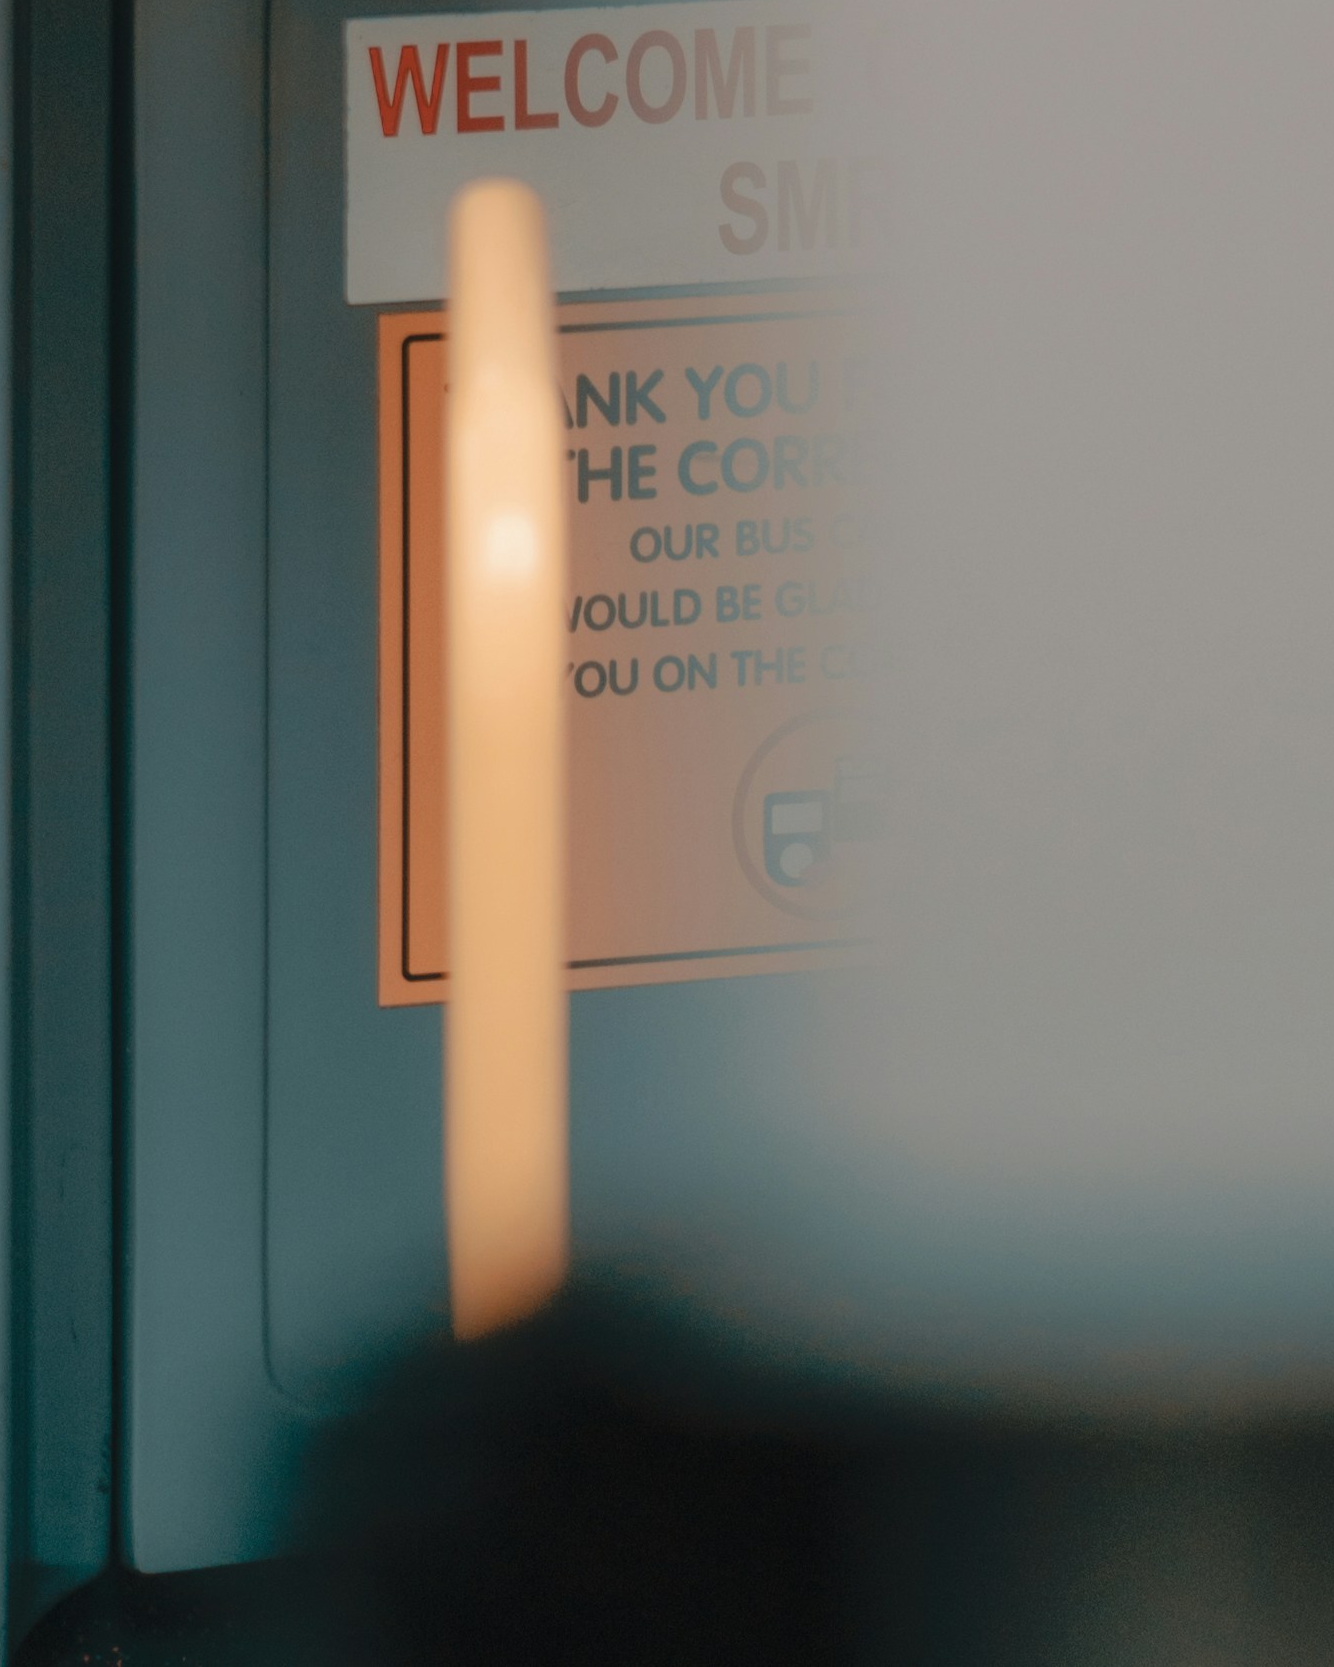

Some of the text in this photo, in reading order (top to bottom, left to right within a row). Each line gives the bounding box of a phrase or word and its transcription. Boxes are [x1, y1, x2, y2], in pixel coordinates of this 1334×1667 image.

[369, 23, 815, 138] WELCOME
[684, 359, 819, 421] YOU
[629, 522, 720, 563] OUR
[736, 517, 816, 557] BUS
[716, 584, 762, 624] BE
[652, 653, 717, 692] ON
[730, 646, 807, 687] THE
